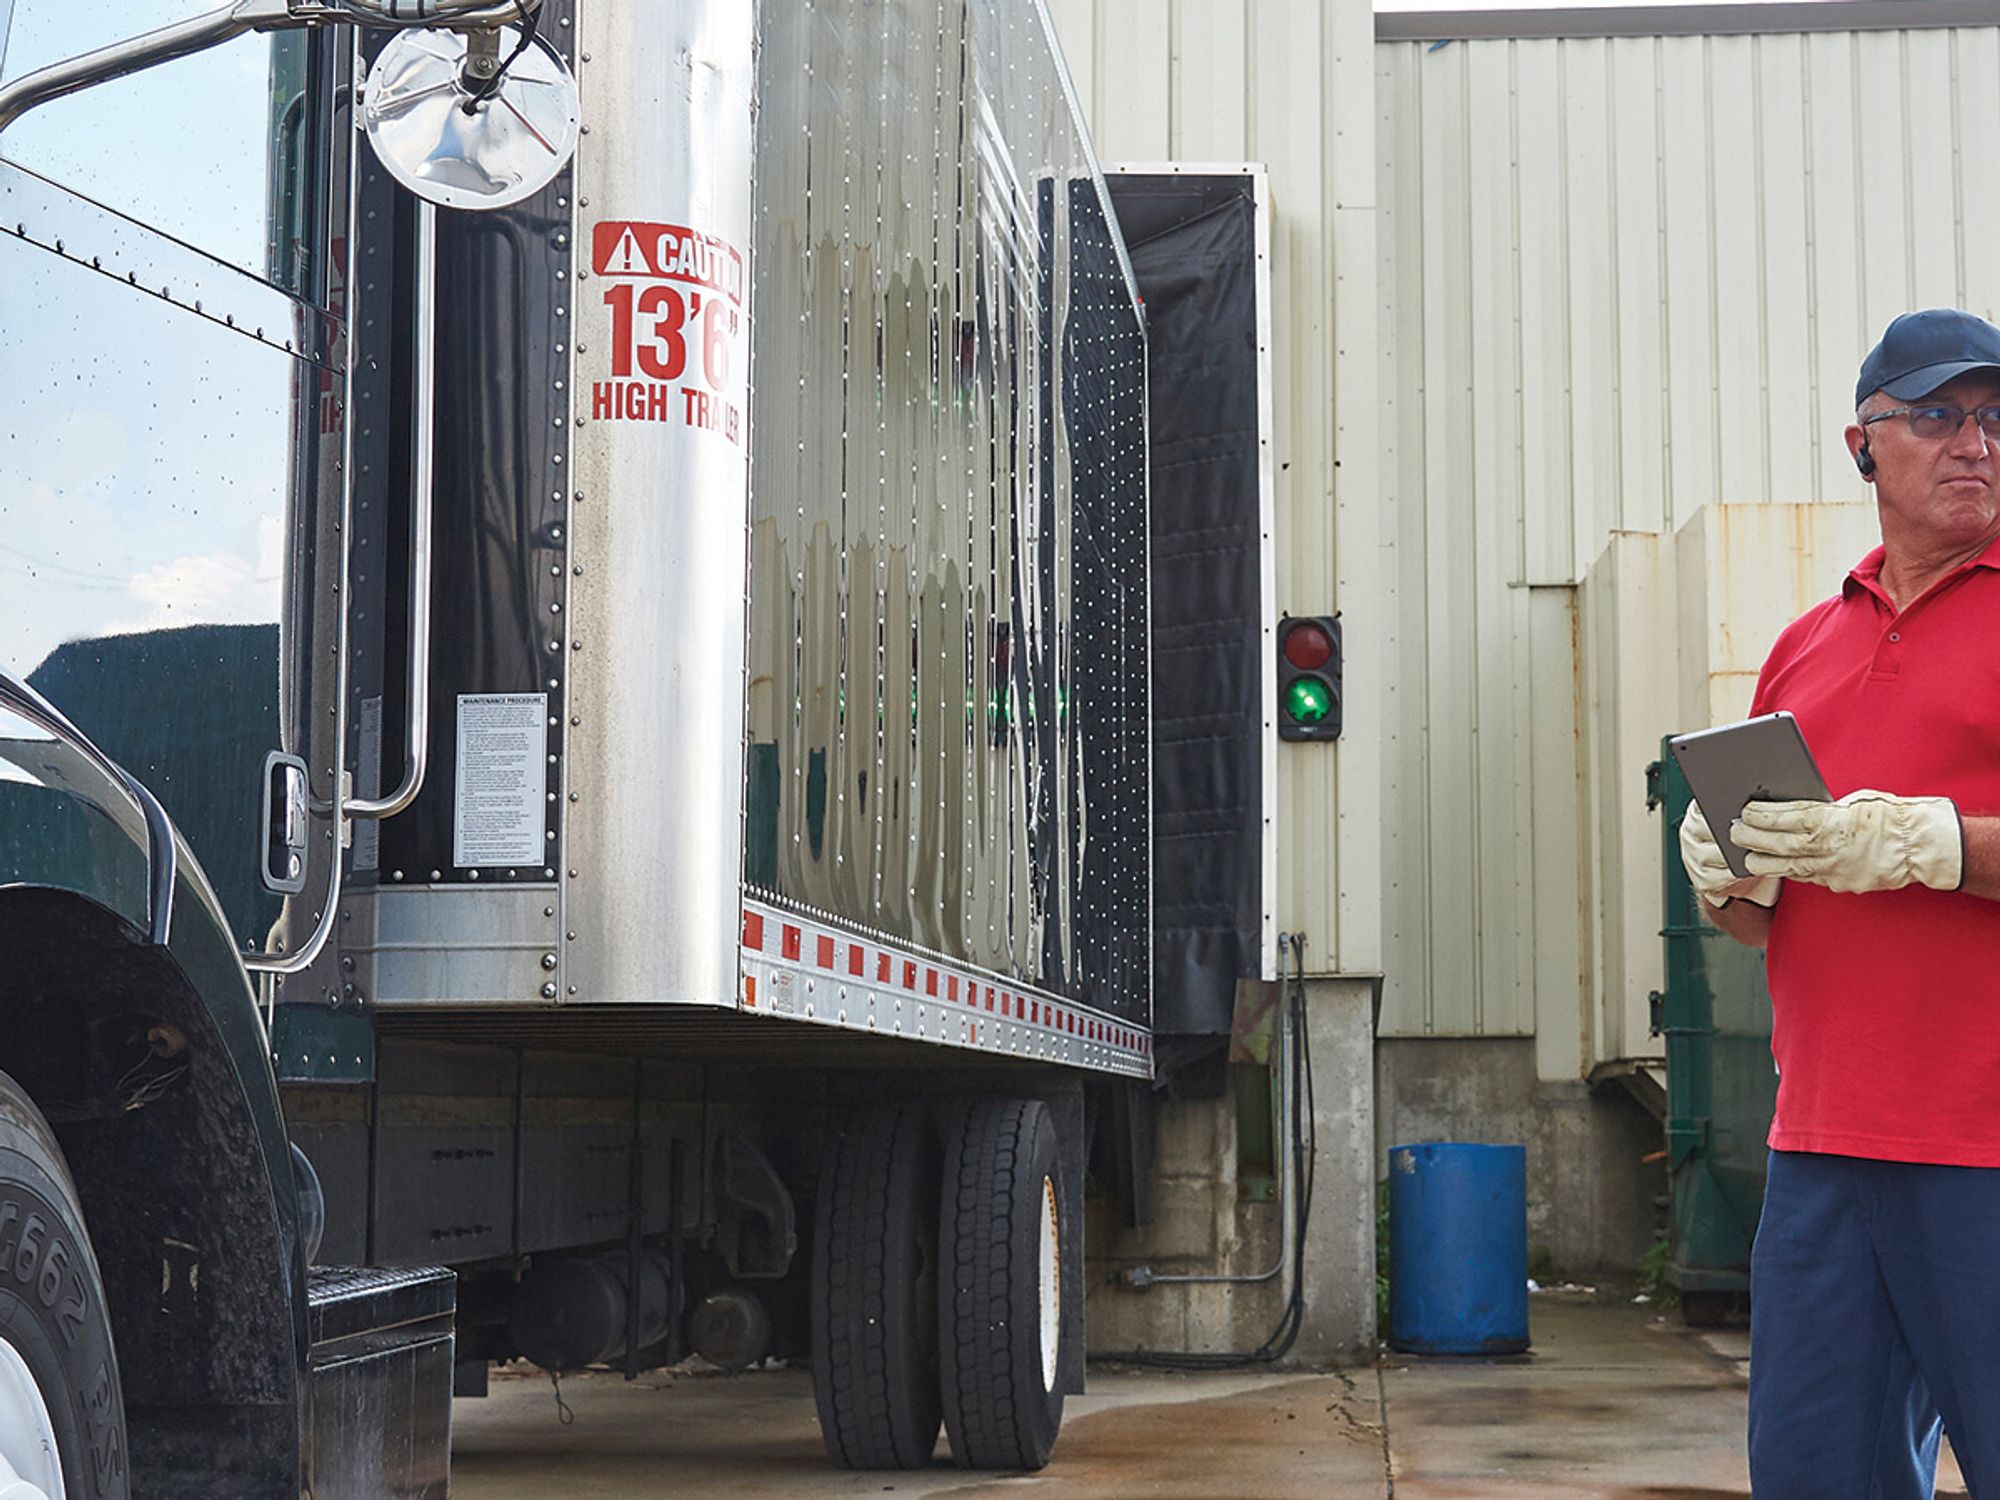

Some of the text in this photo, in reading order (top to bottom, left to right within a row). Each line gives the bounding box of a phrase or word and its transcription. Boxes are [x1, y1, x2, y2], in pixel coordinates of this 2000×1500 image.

[657, 232, 739, 300] CAUTI
[593, 382, 667, 422] HIGH
[463, 695, 541, 705] MAINTENANCE PROCEDURE
